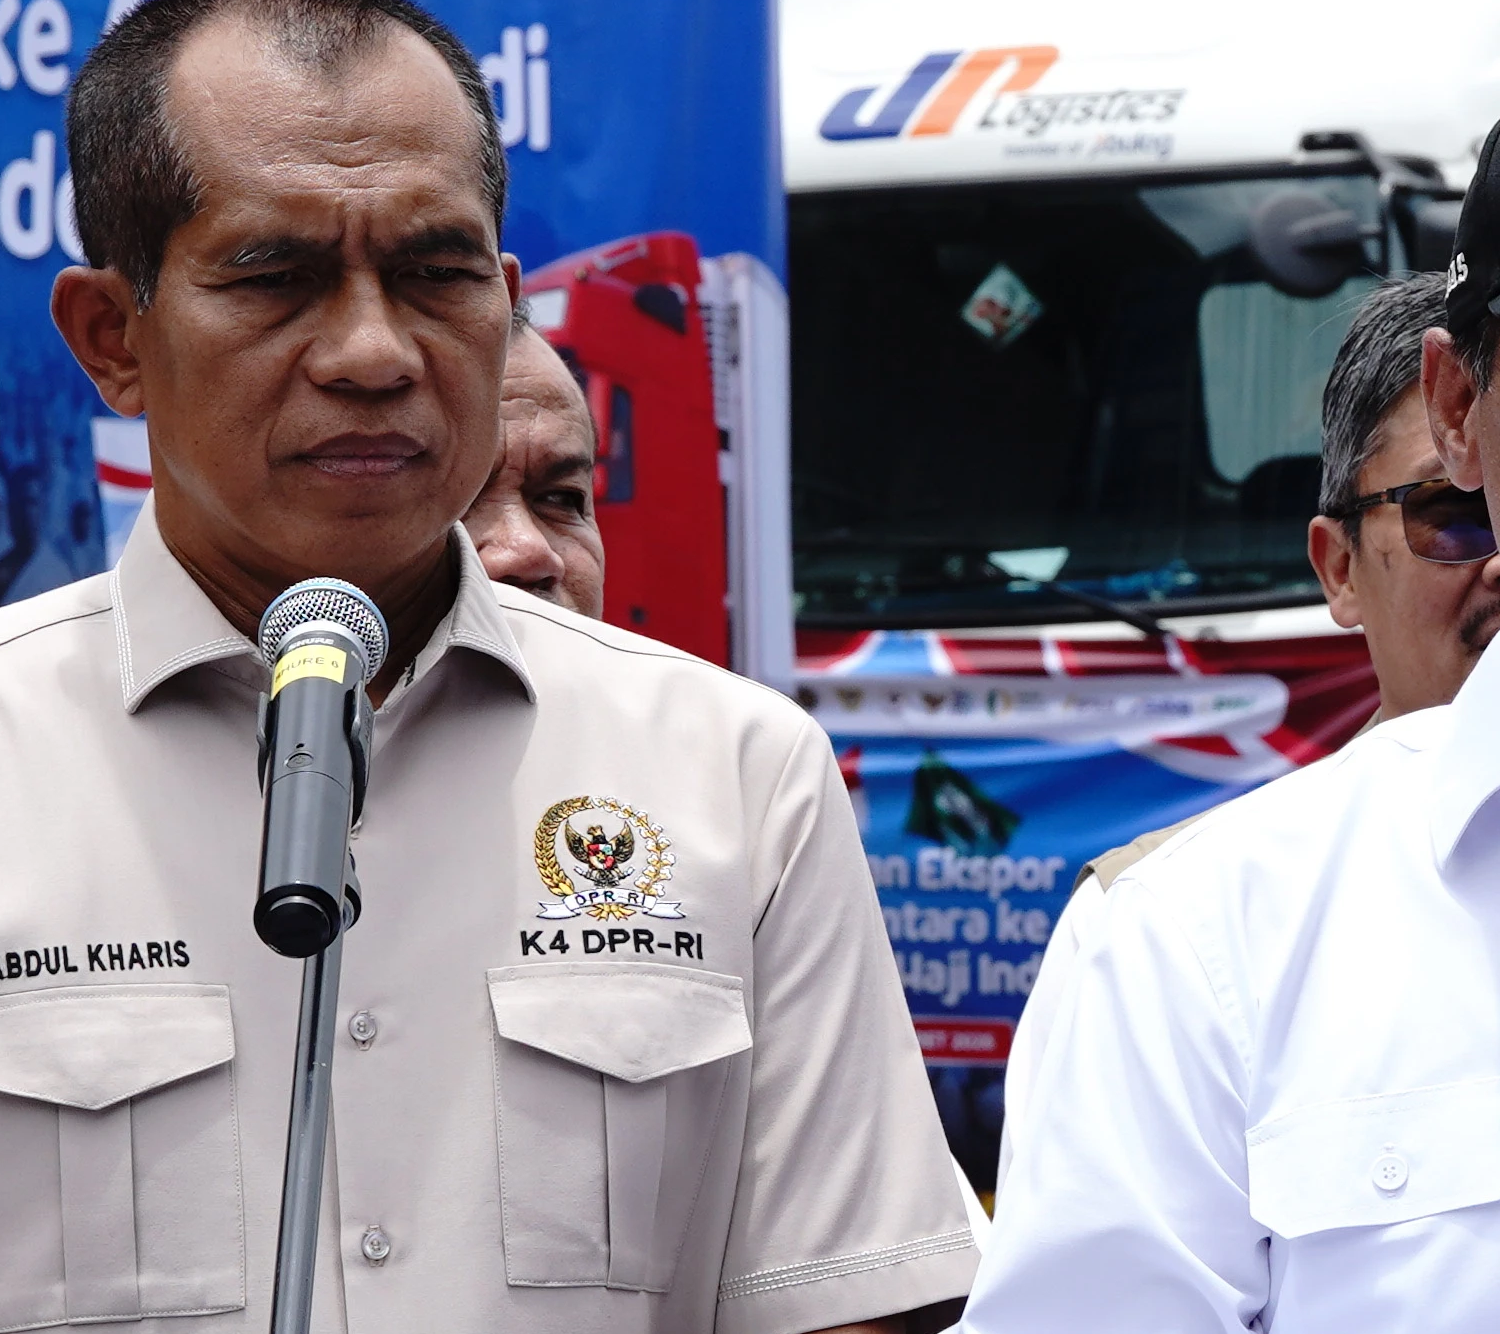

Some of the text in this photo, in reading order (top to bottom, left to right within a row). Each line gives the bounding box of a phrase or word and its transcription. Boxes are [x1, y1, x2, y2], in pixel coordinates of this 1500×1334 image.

[977, 88, 1186, 138] Logistics
[916, 847, 1066, 902] Ekspor
[86, 940, 190, 973] KHARIS
[520, 928, 705, 961] K4 DPR-RI
